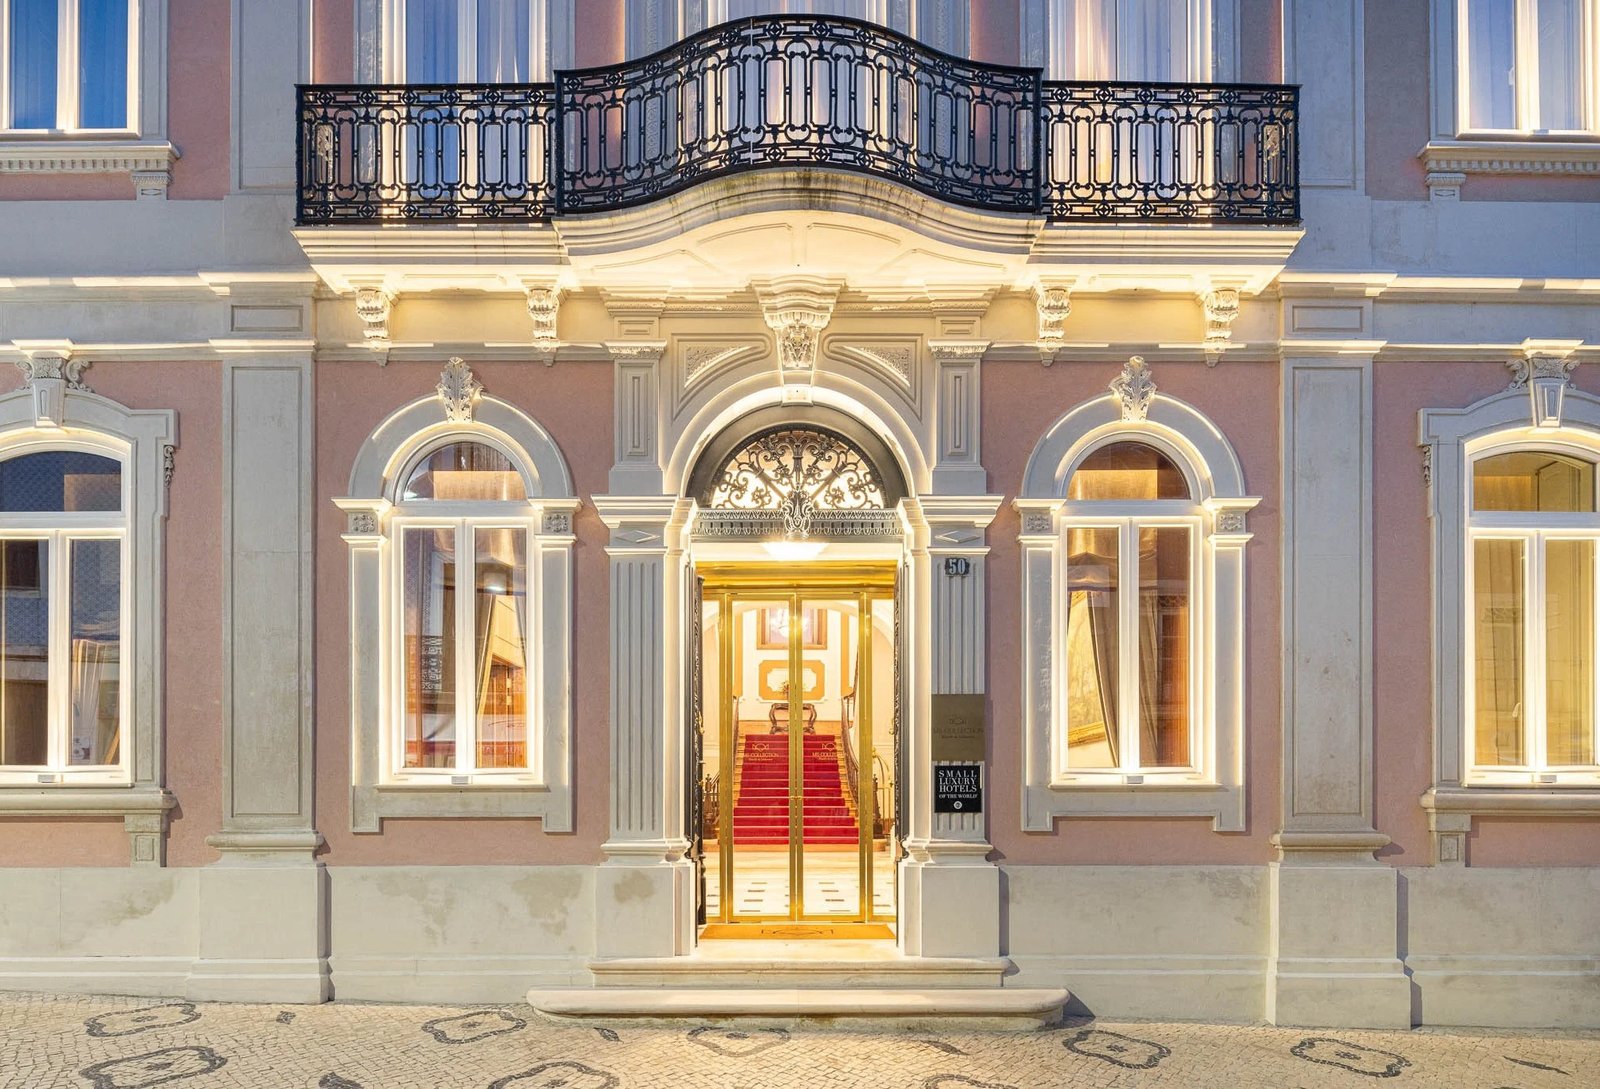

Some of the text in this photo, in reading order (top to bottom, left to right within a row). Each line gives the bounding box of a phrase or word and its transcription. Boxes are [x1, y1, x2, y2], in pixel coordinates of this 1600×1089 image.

[949, 558, 966, 574] 50
[938, 770, 977, 778] SMALL
[939, 777, 977, 785] LUXURY
[939, 784, 977, 793] HOTELS
